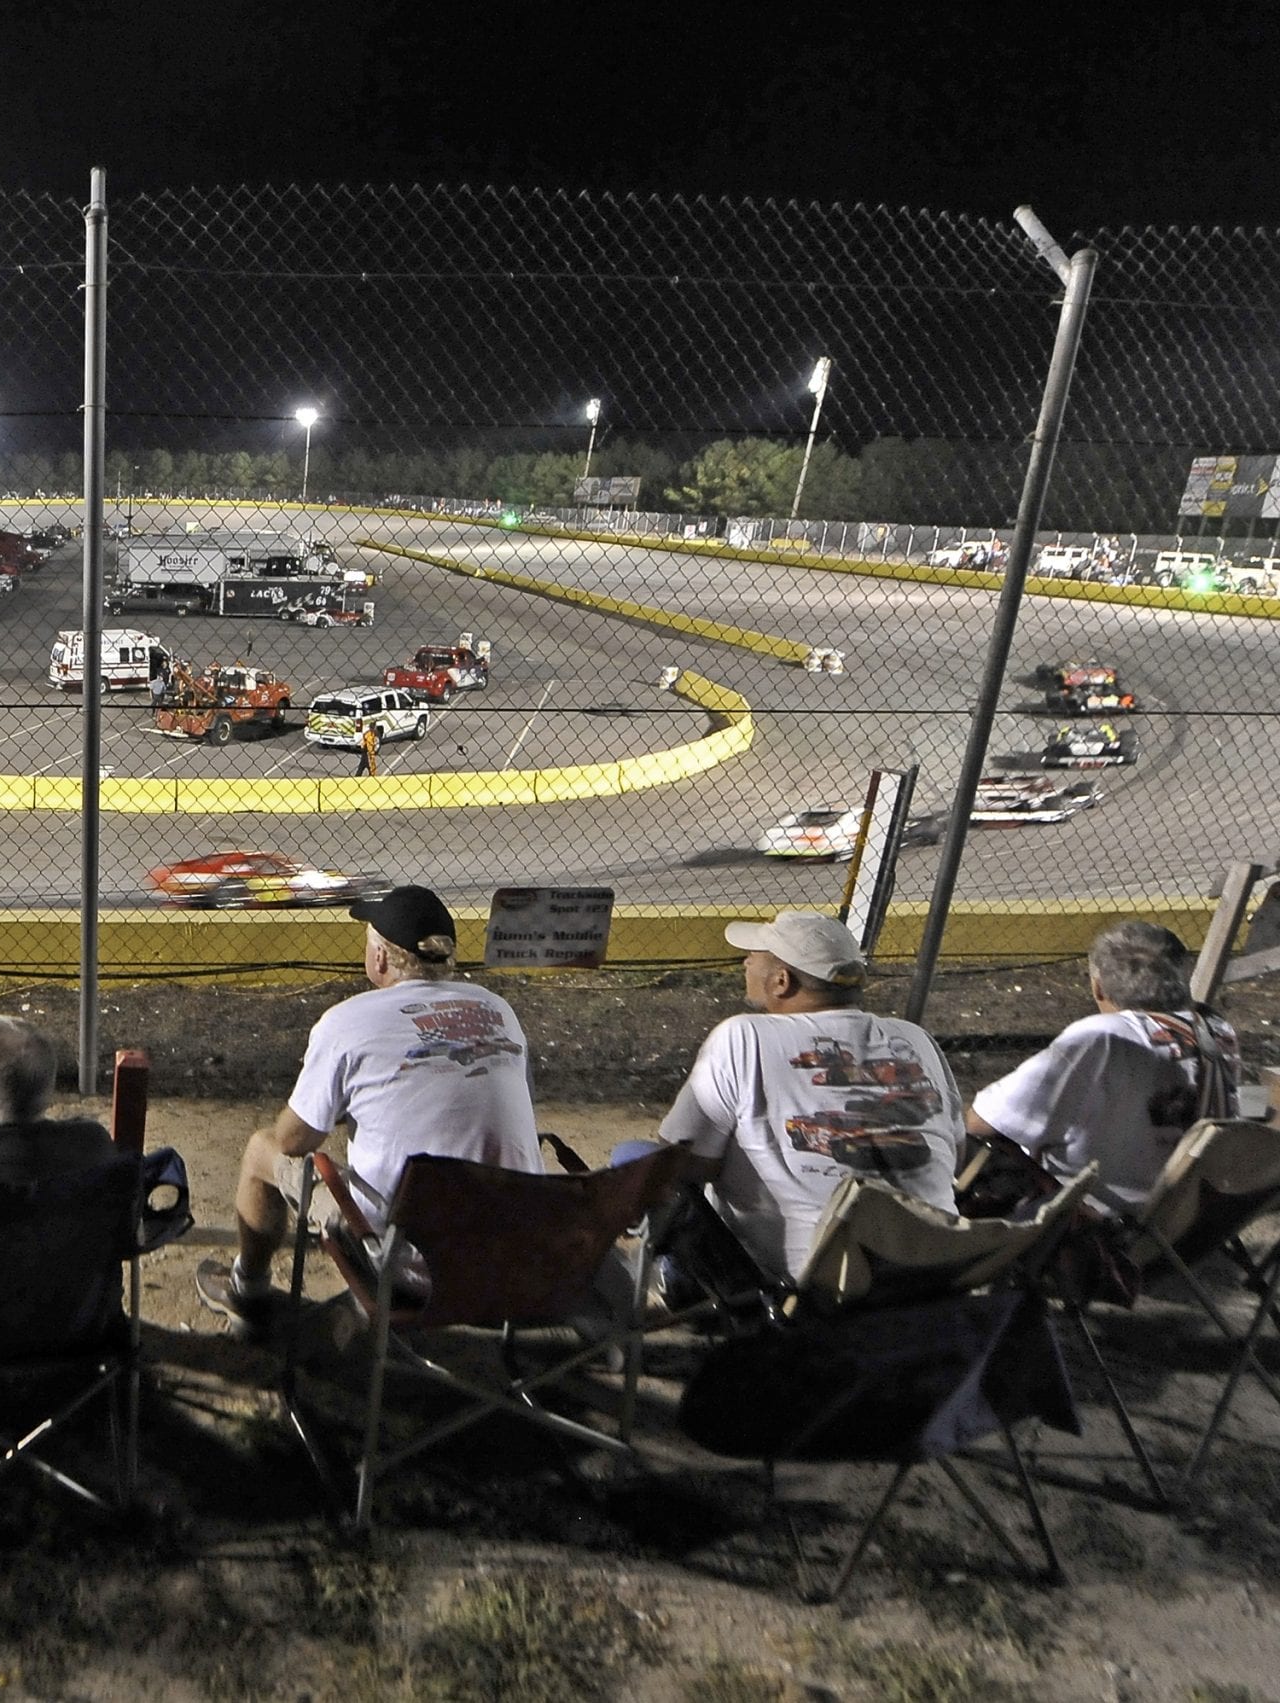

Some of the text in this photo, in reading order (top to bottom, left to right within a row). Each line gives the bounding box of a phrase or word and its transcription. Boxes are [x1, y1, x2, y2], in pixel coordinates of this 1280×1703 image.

[550, 904, 579, 915] Spot
[496, 949, 595, 960] Truck Repair
